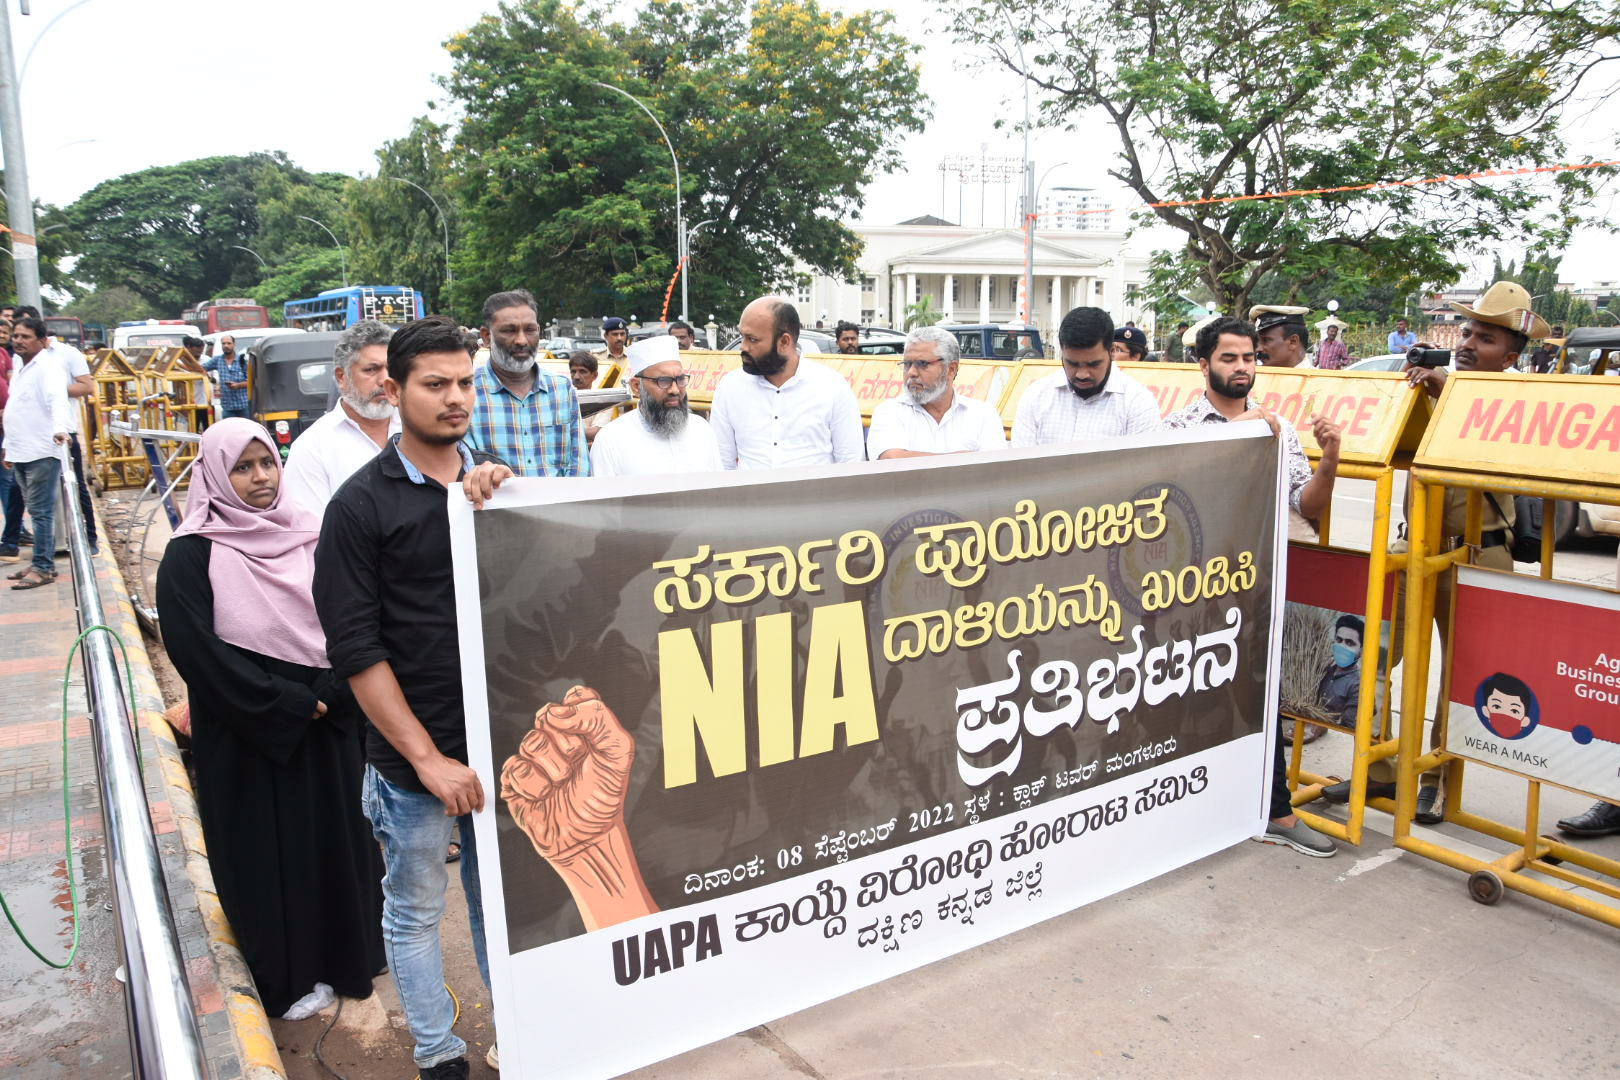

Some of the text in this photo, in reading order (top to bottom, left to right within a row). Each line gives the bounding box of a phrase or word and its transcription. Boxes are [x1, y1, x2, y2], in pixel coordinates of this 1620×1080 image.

[653, 489, 1169, 613] ಸರ್ಕಾರಿ ಪ್ರಾಯೋಜಿತ
[658, 551, 1256, 789] NIA ದಾಳಿಯನ್ನು ಖಂಡಿಸಿ
[955, 607, 1242, 786] ಪ್ರತಿಭಟನೆ
[1574, 683, 1619, 705] Grou
[684, 854, 765, 894] ದಿನಾಂಕ:
[777, 845, 803, 869] 08
[815, 817, 897, 863] ಸೆಪ್ಟೆಂಬರ್
[908, 803, 954, 832] 2022
[964, 790, 990, 825] ಸ್ಥಳ
[1013, 775, 1047, 809] ಕ್ಲಾಕ್
[1056, 759, 1099, 789] ಟವರ್
[1106, 735, 1177, 773] ಮಂಗಳೂರು
[1465, 736, 1549, 768] WEAR A MASK
[612, 765, 1209, 986] UAPA ಕಾಯ್ದೆ ವಿರೋಧಿ ಹೋರಾಟ ಸಮಿತಿ
[858, 861, 1043, 952] ದಕ್ಷಿಣ ಕನ್ನಡ ಜಿಲ್ಲೆ
